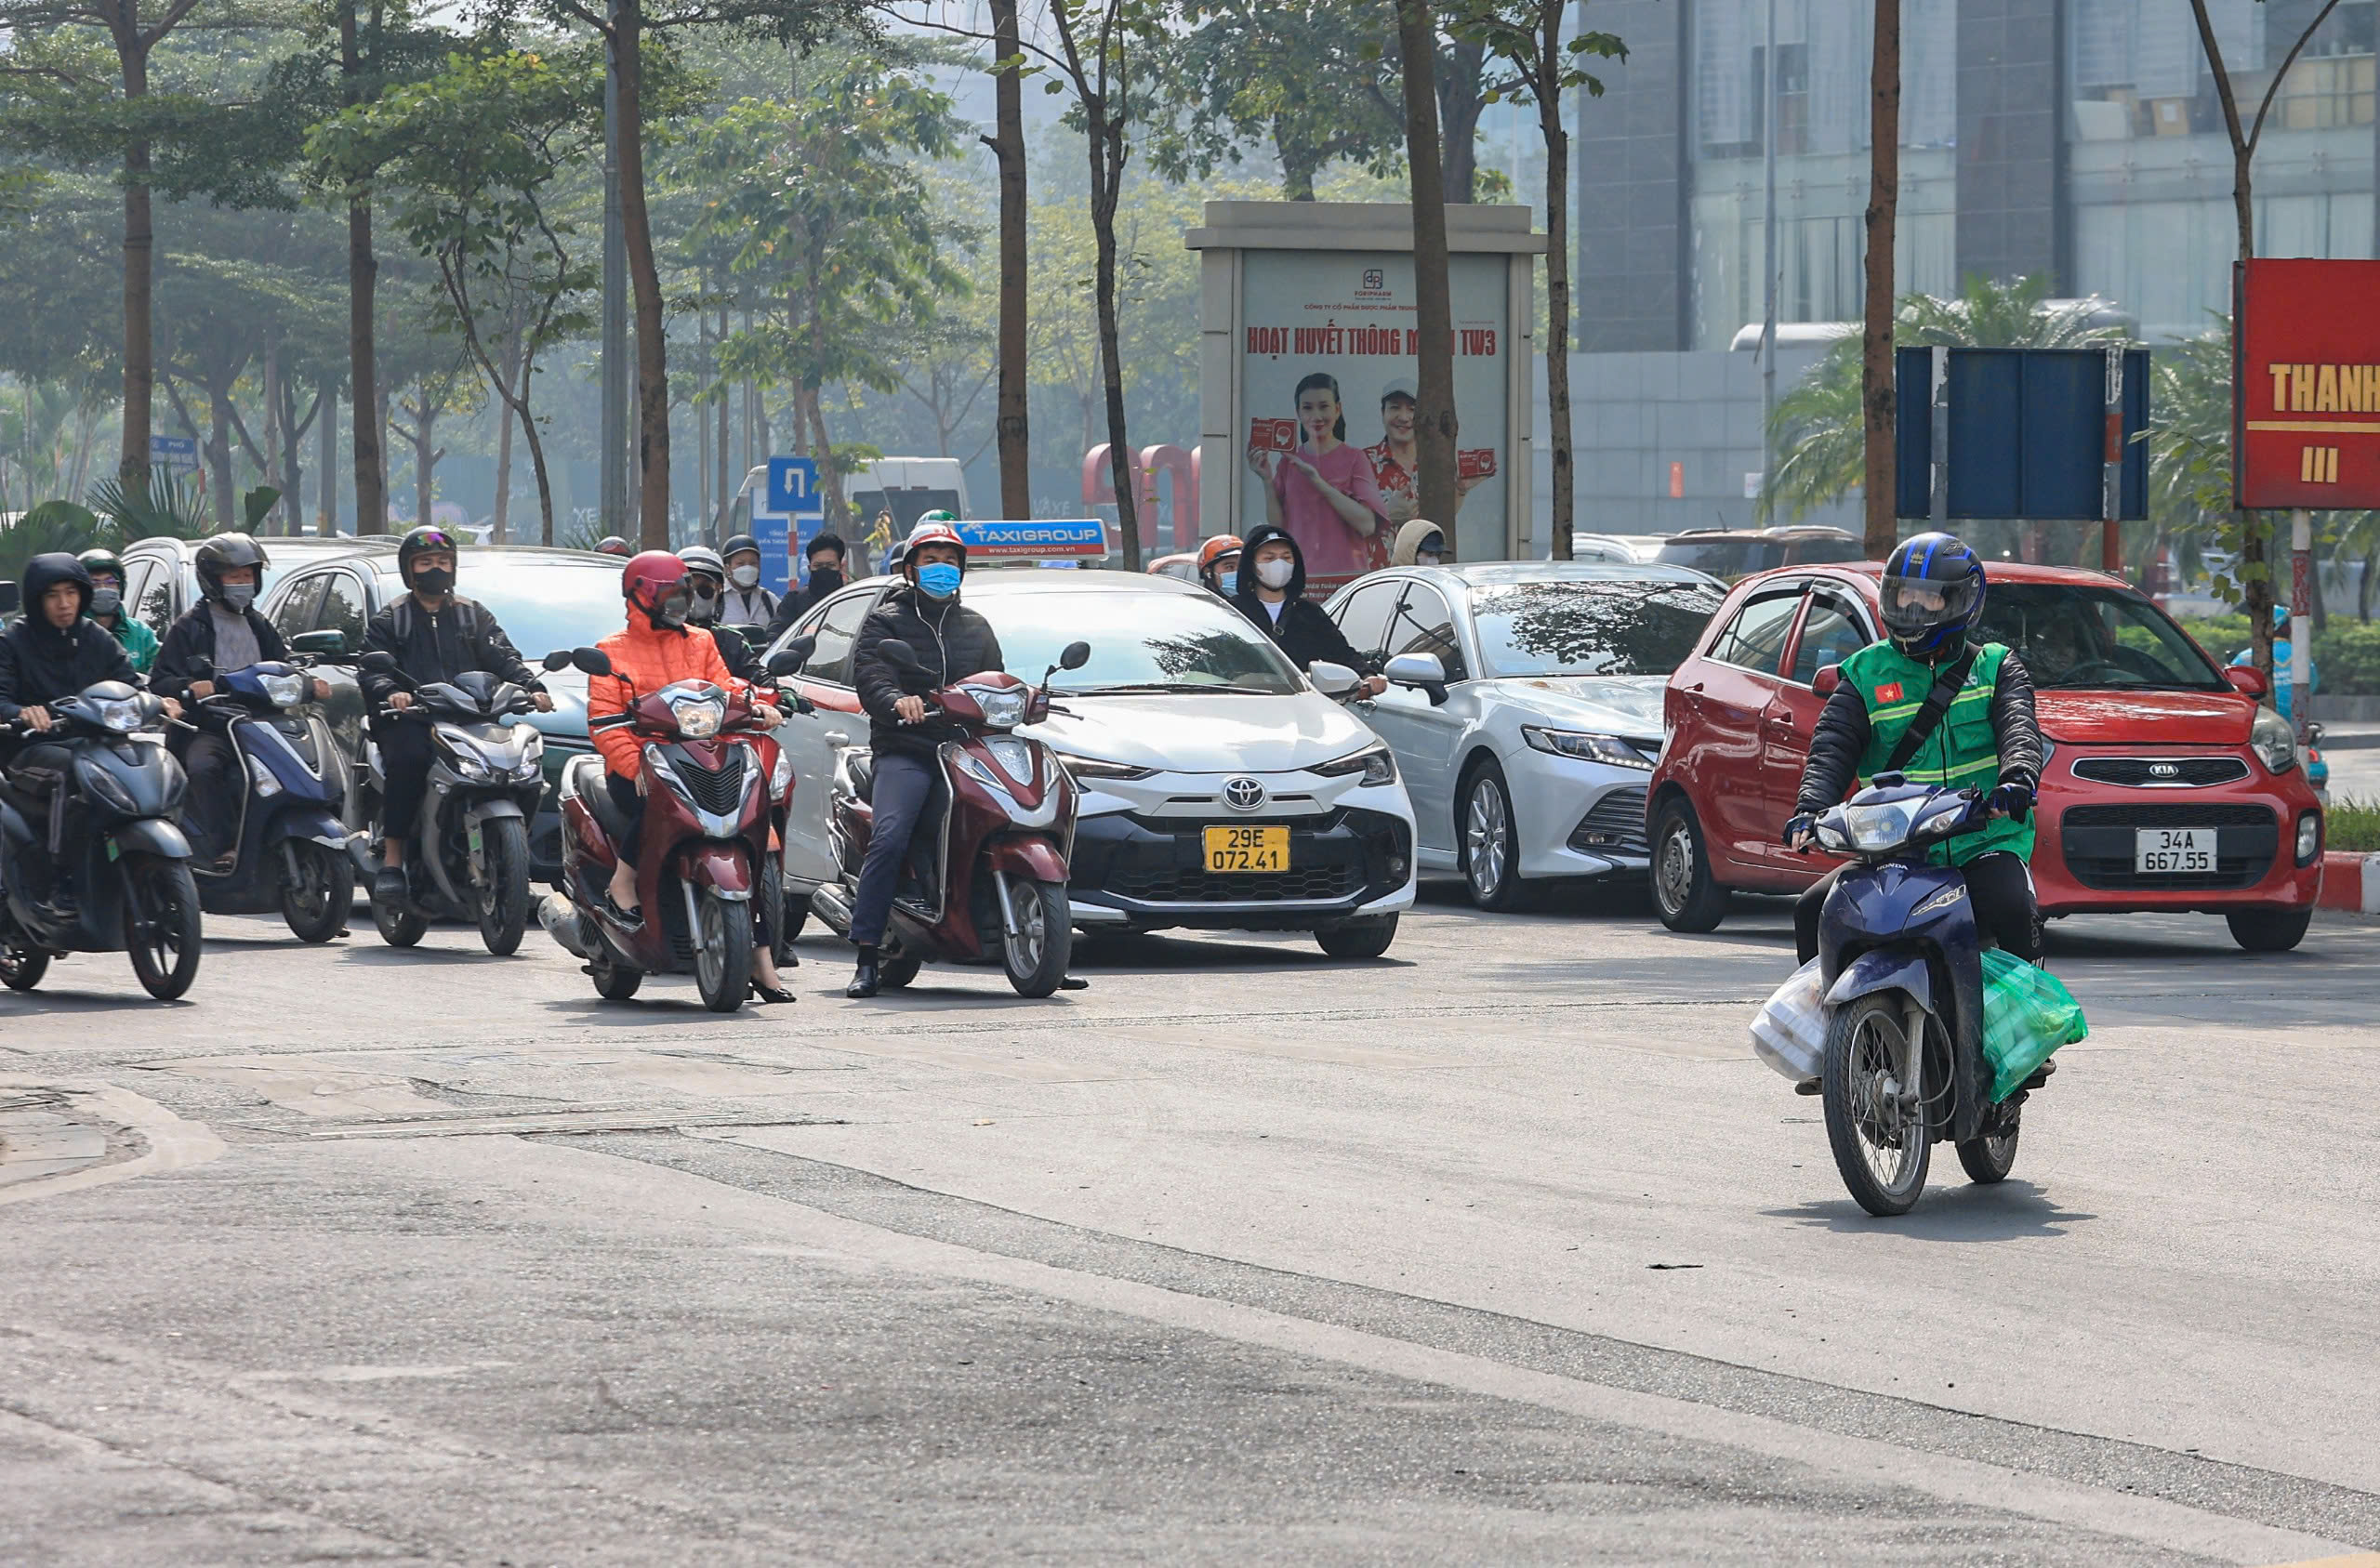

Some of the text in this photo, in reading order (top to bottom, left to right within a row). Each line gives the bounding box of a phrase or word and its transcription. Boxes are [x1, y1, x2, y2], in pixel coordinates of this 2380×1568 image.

[1247, 326, 1289, 360] HOẠT
[1294, 319, 1344, 355] HUYẾT
[1347, 323, 1401, 356] THÔNG
[1461, 329, 1496, 356] TW3
[2269, 363, 2380, 412] THANH
[974, 529, 1098, 542] TAXIGROUP
[988, 546, 1076, 554] www.taxigroup.com.vn
[2154, 765, 2175, 774] KIA
[1228, 829, 1264, 849] 29E
[2160, 831, 2194, 850] 34A
[1212, 850, 1277, 870] 072.41
[1876, 863, 1909, 871] HONDA
[2146, 851, 2208, 870] 667.55
